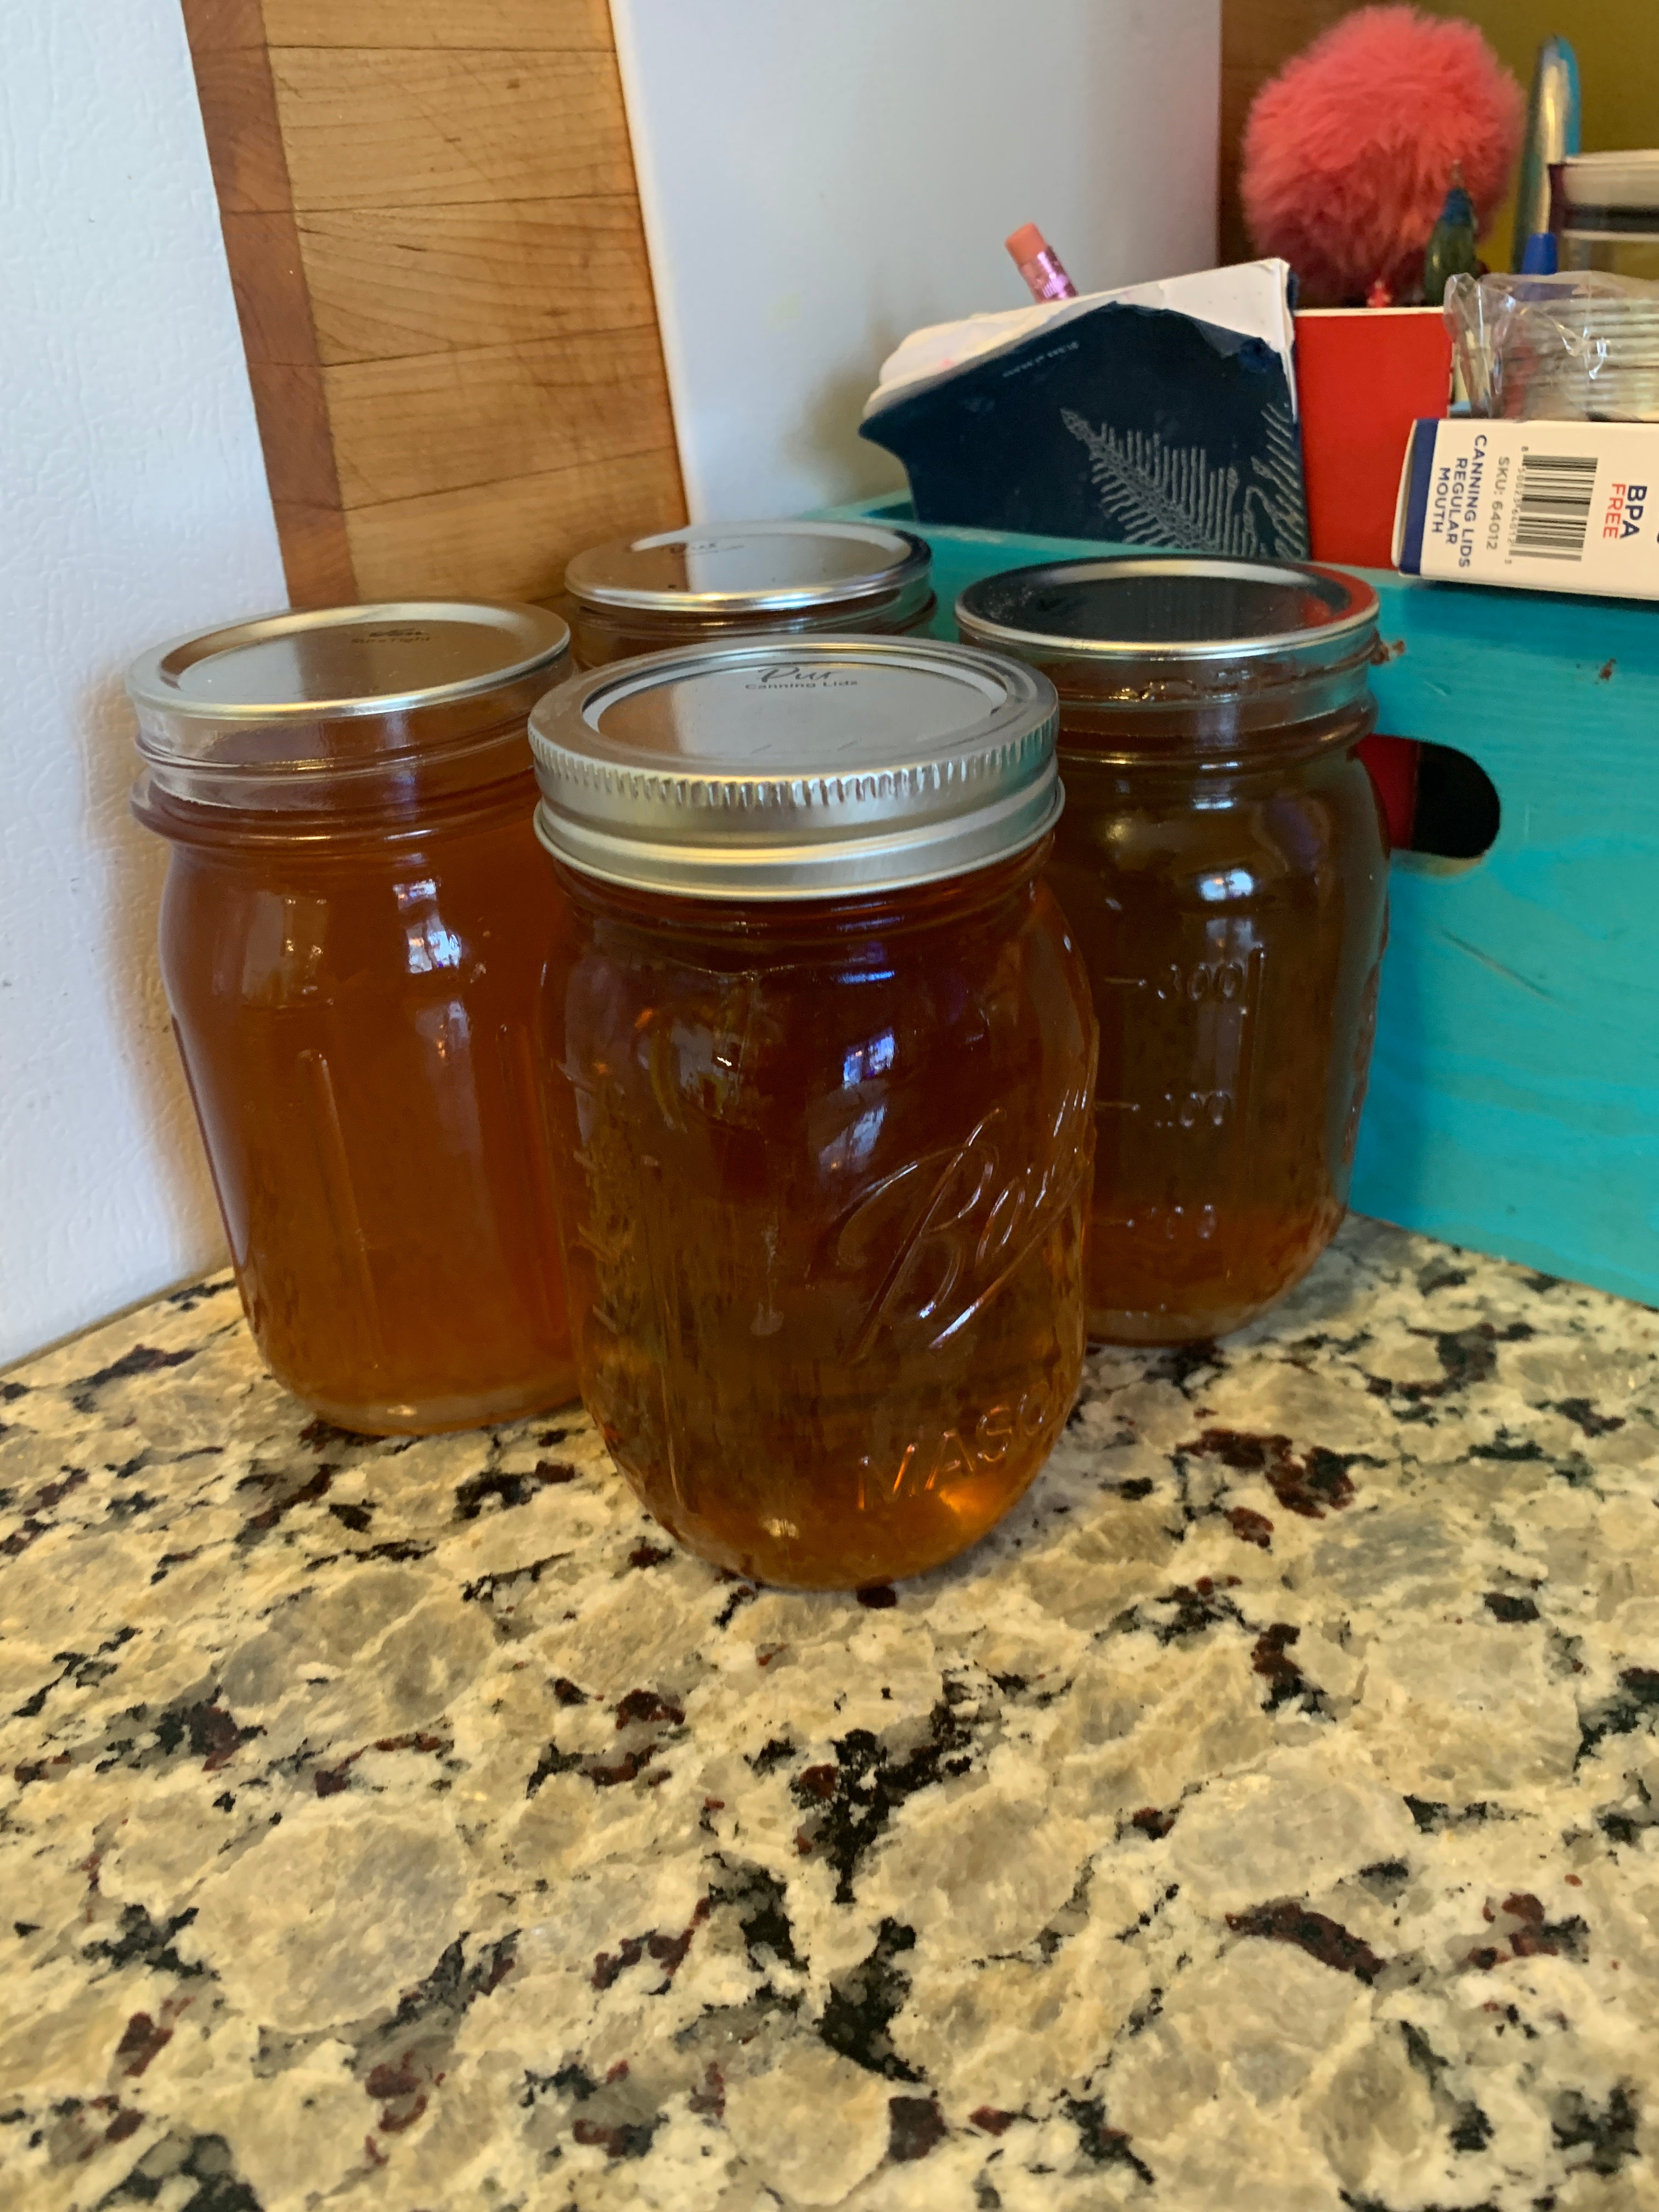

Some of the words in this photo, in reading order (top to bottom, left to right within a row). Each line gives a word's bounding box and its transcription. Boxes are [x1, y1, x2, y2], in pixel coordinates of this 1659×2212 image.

[1431, 467, 1451, 533] MOUTH
[1446, 458, 1468, 544] REGULAR
[1464, 435, 1487, 522] CANNING
[1493, 456, 1510, 495] SKU:
[1486, 500, 1503, 550] 64012
[1602, 483, 1626, 538] FREE
[1620, 486, 1647, 539] BPA
[1458, 528, 1474, 567] LIDS
